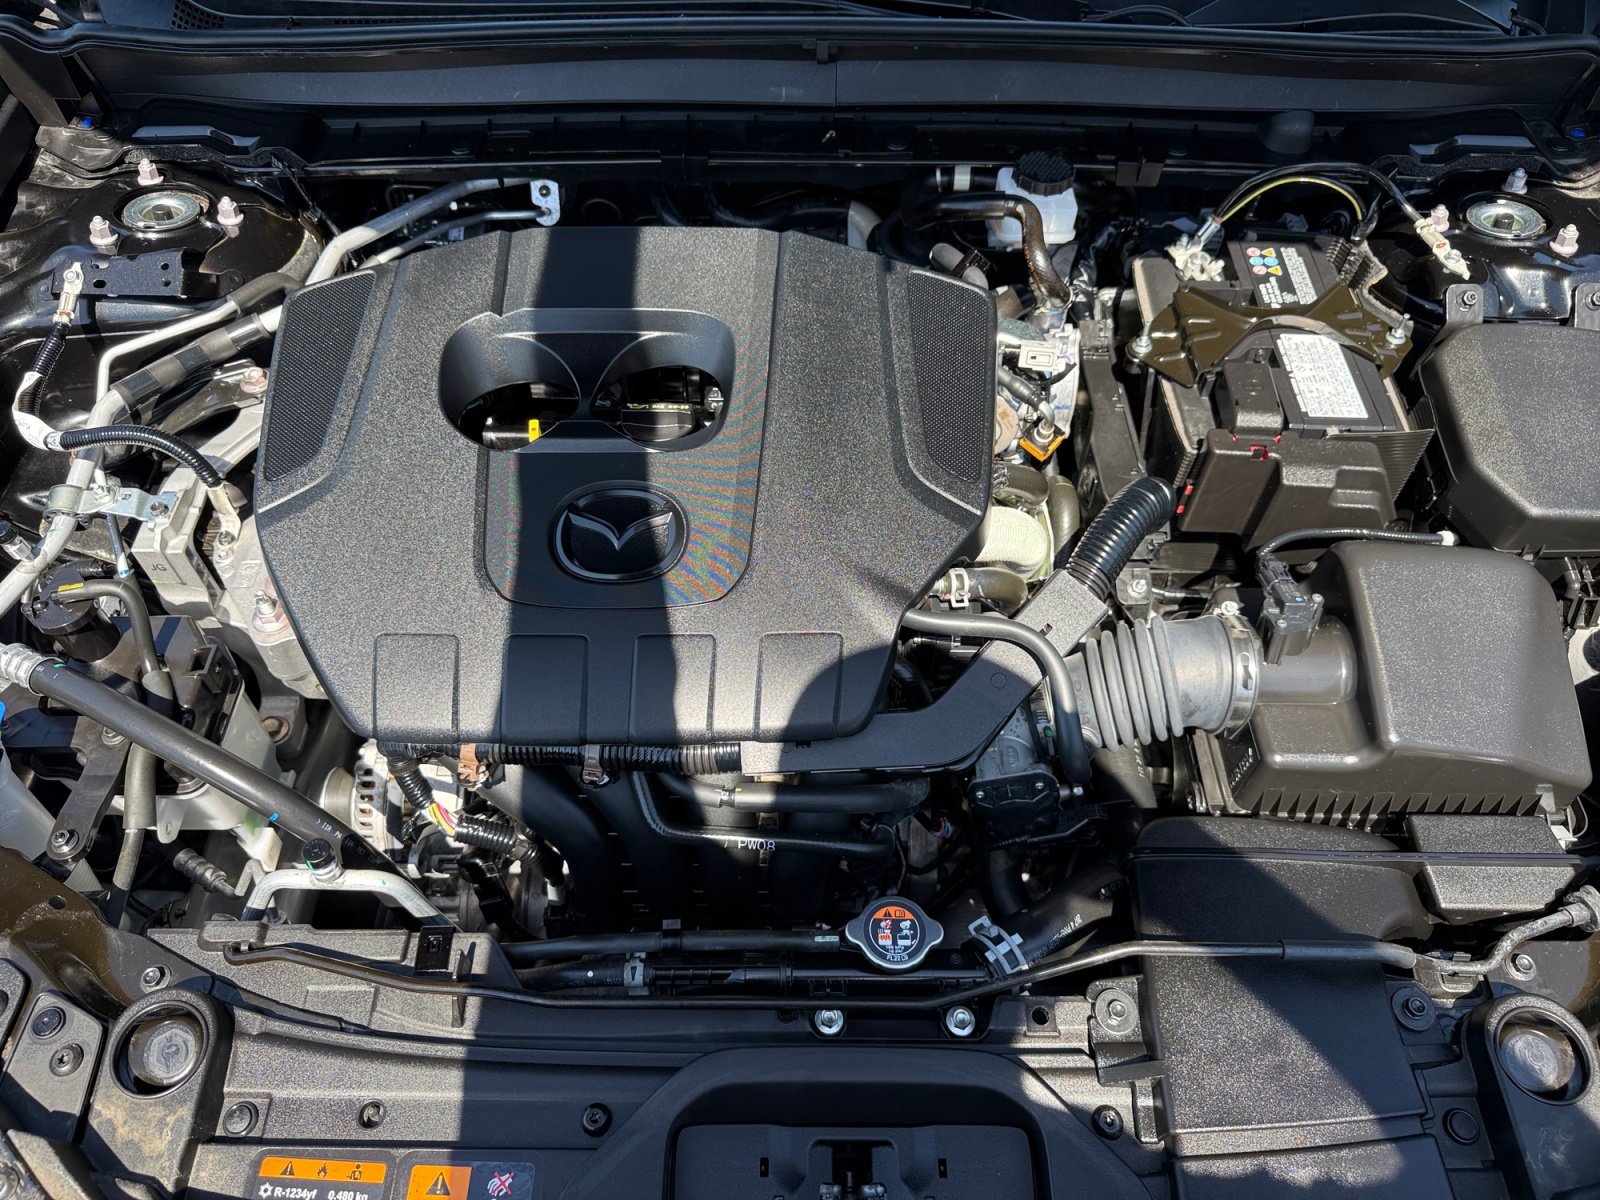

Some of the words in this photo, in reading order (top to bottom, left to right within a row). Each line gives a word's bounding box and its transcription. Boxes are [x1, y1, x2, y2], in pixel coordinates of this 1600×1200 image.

[737, 839, 776, 851] PW08
[273, 1186, 318, 1200] R-1234yf
[327, 1190, 354, 1200] 0.480
